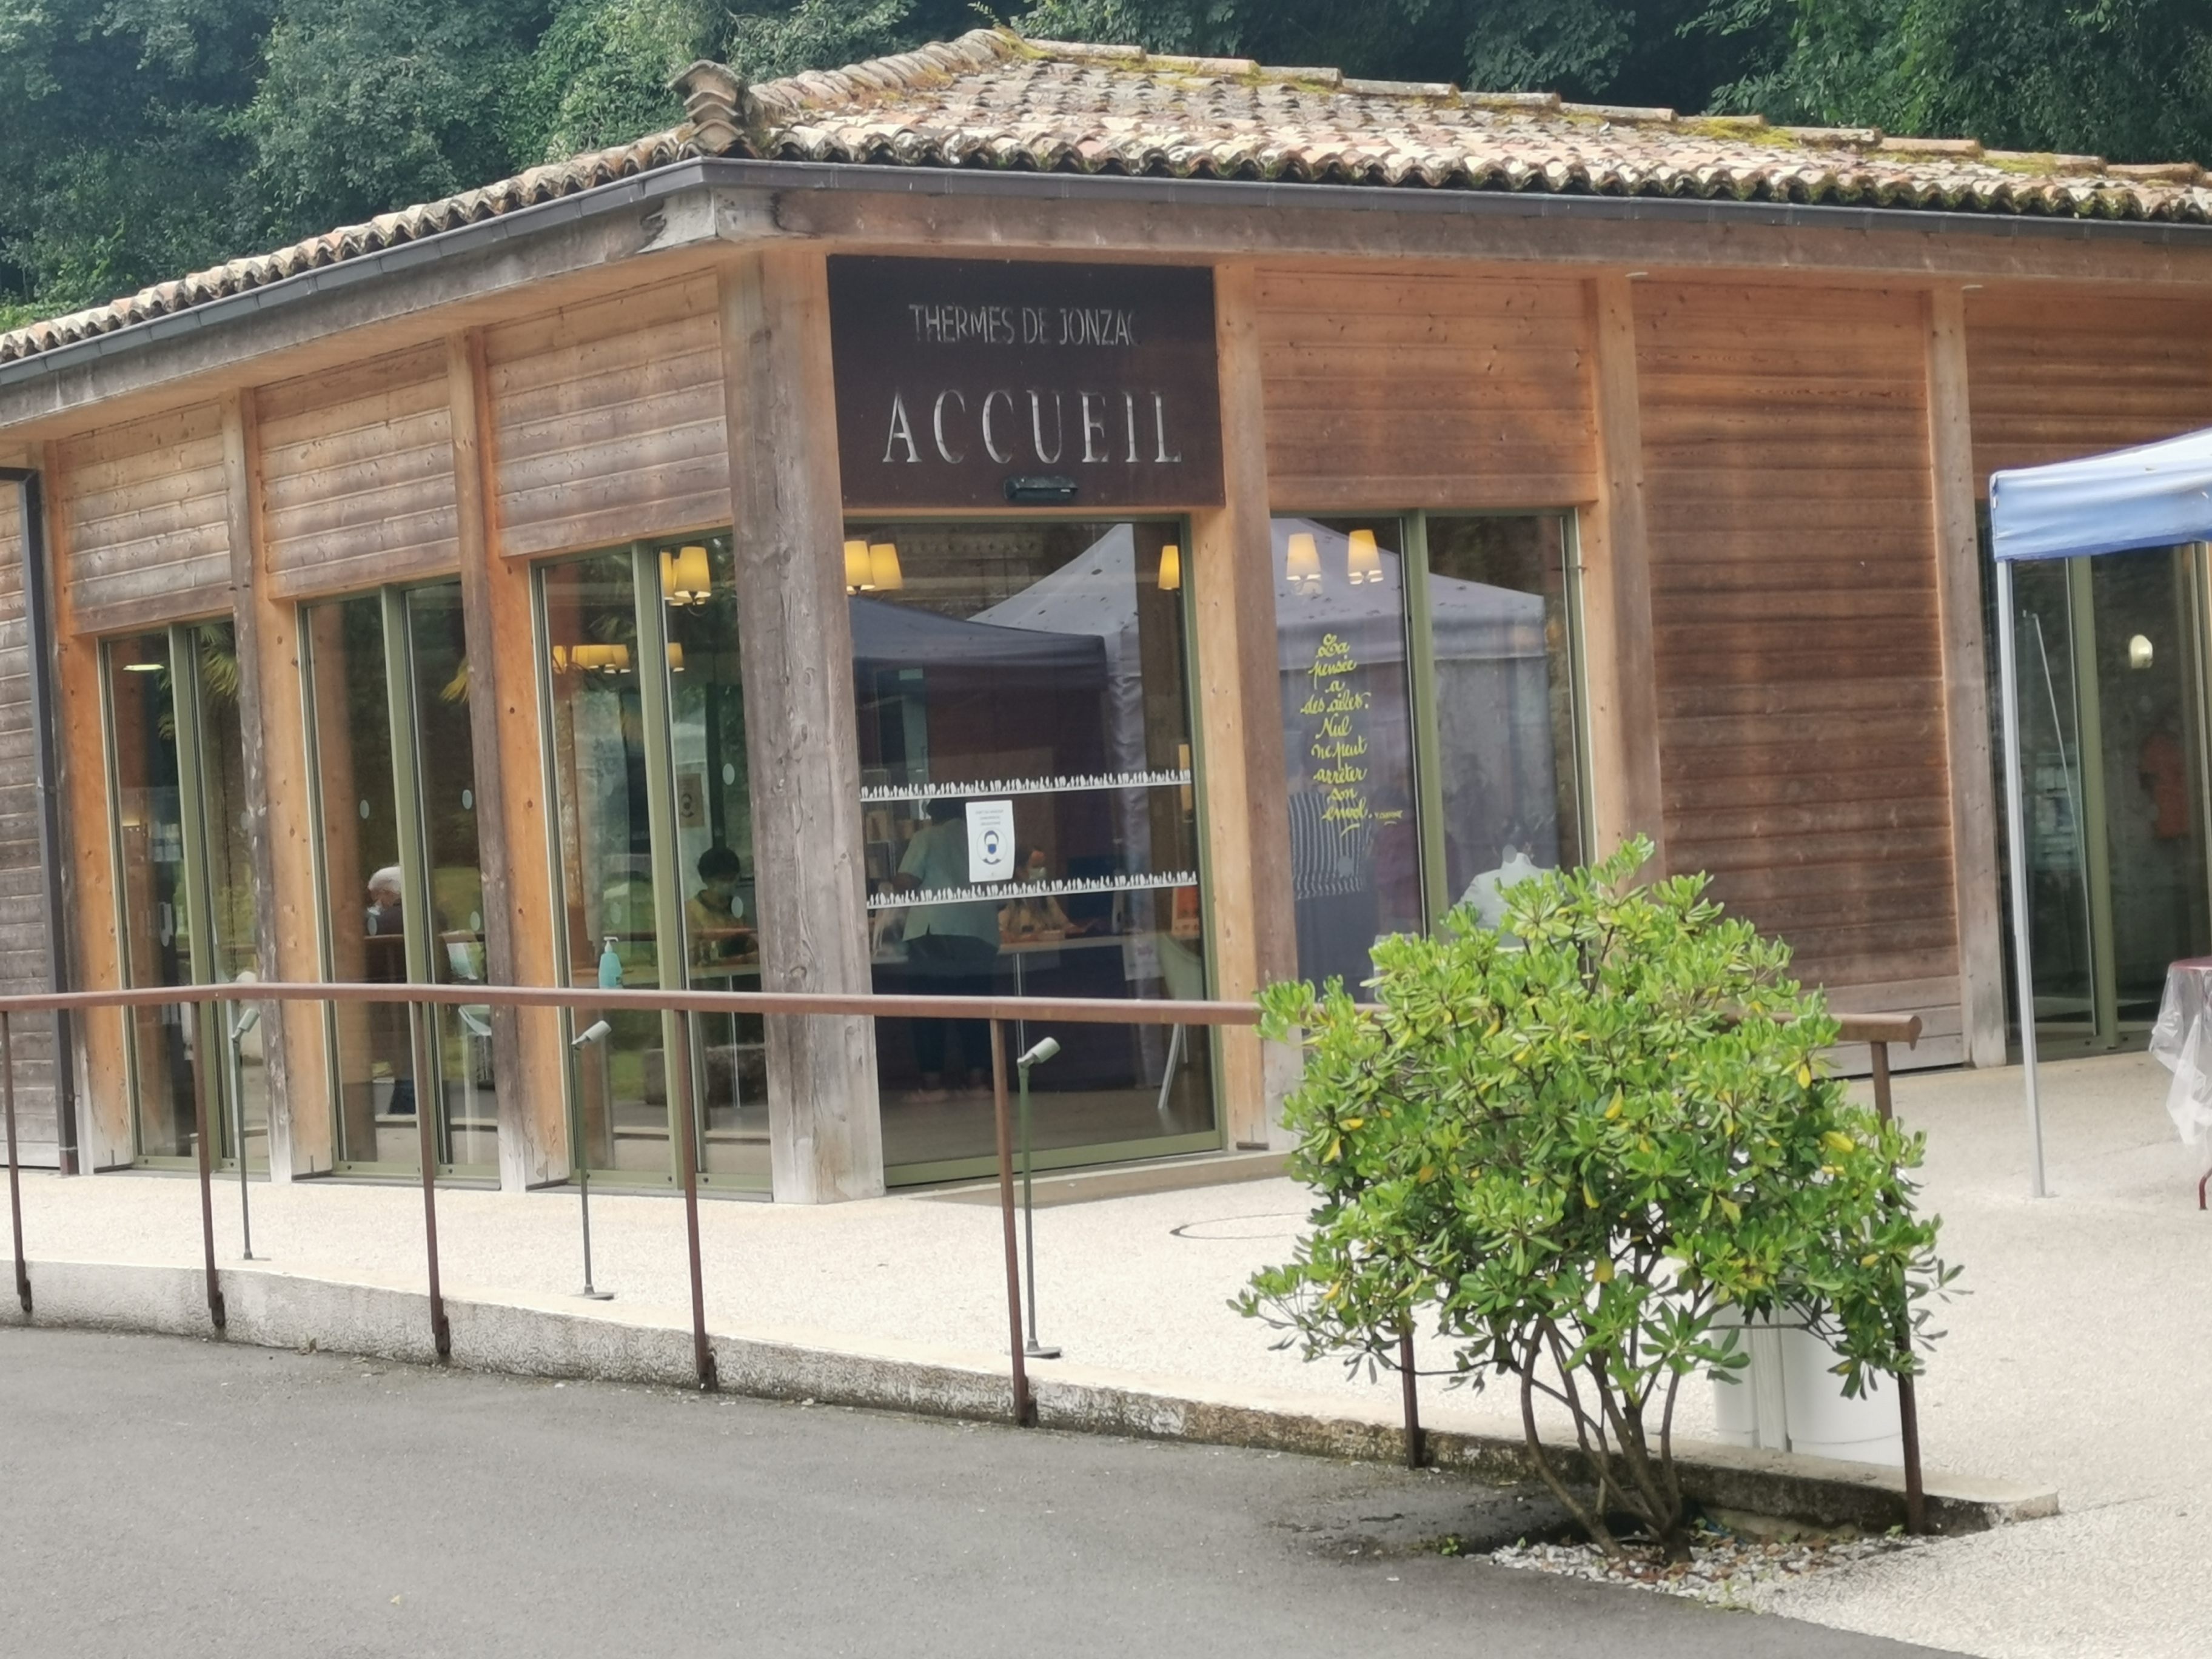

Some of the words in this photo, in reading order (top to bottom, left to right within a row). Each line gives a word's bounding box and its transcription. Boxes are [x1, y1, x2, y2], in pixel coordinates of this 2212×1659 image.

[908, 304, 1015, 344] THERMES
[1022, 306, 1047, 344] DE
[1059, 307, 1139, 346] JONZAC
[882, 389, 1182, 464] ACCUEIL
[1315, 633, 1350, 659] La
[1308, 654, 1358, 690] pensée
[1325, 680, 1346, 693] a
[1300, 694, 1325, 714] des
[1315, 712, 1353, 739] Nul
[1311, 743, 1332, 760] ne
[1332, 734, 1368, 772] peut
[1327, 788, 1358, 804] son
